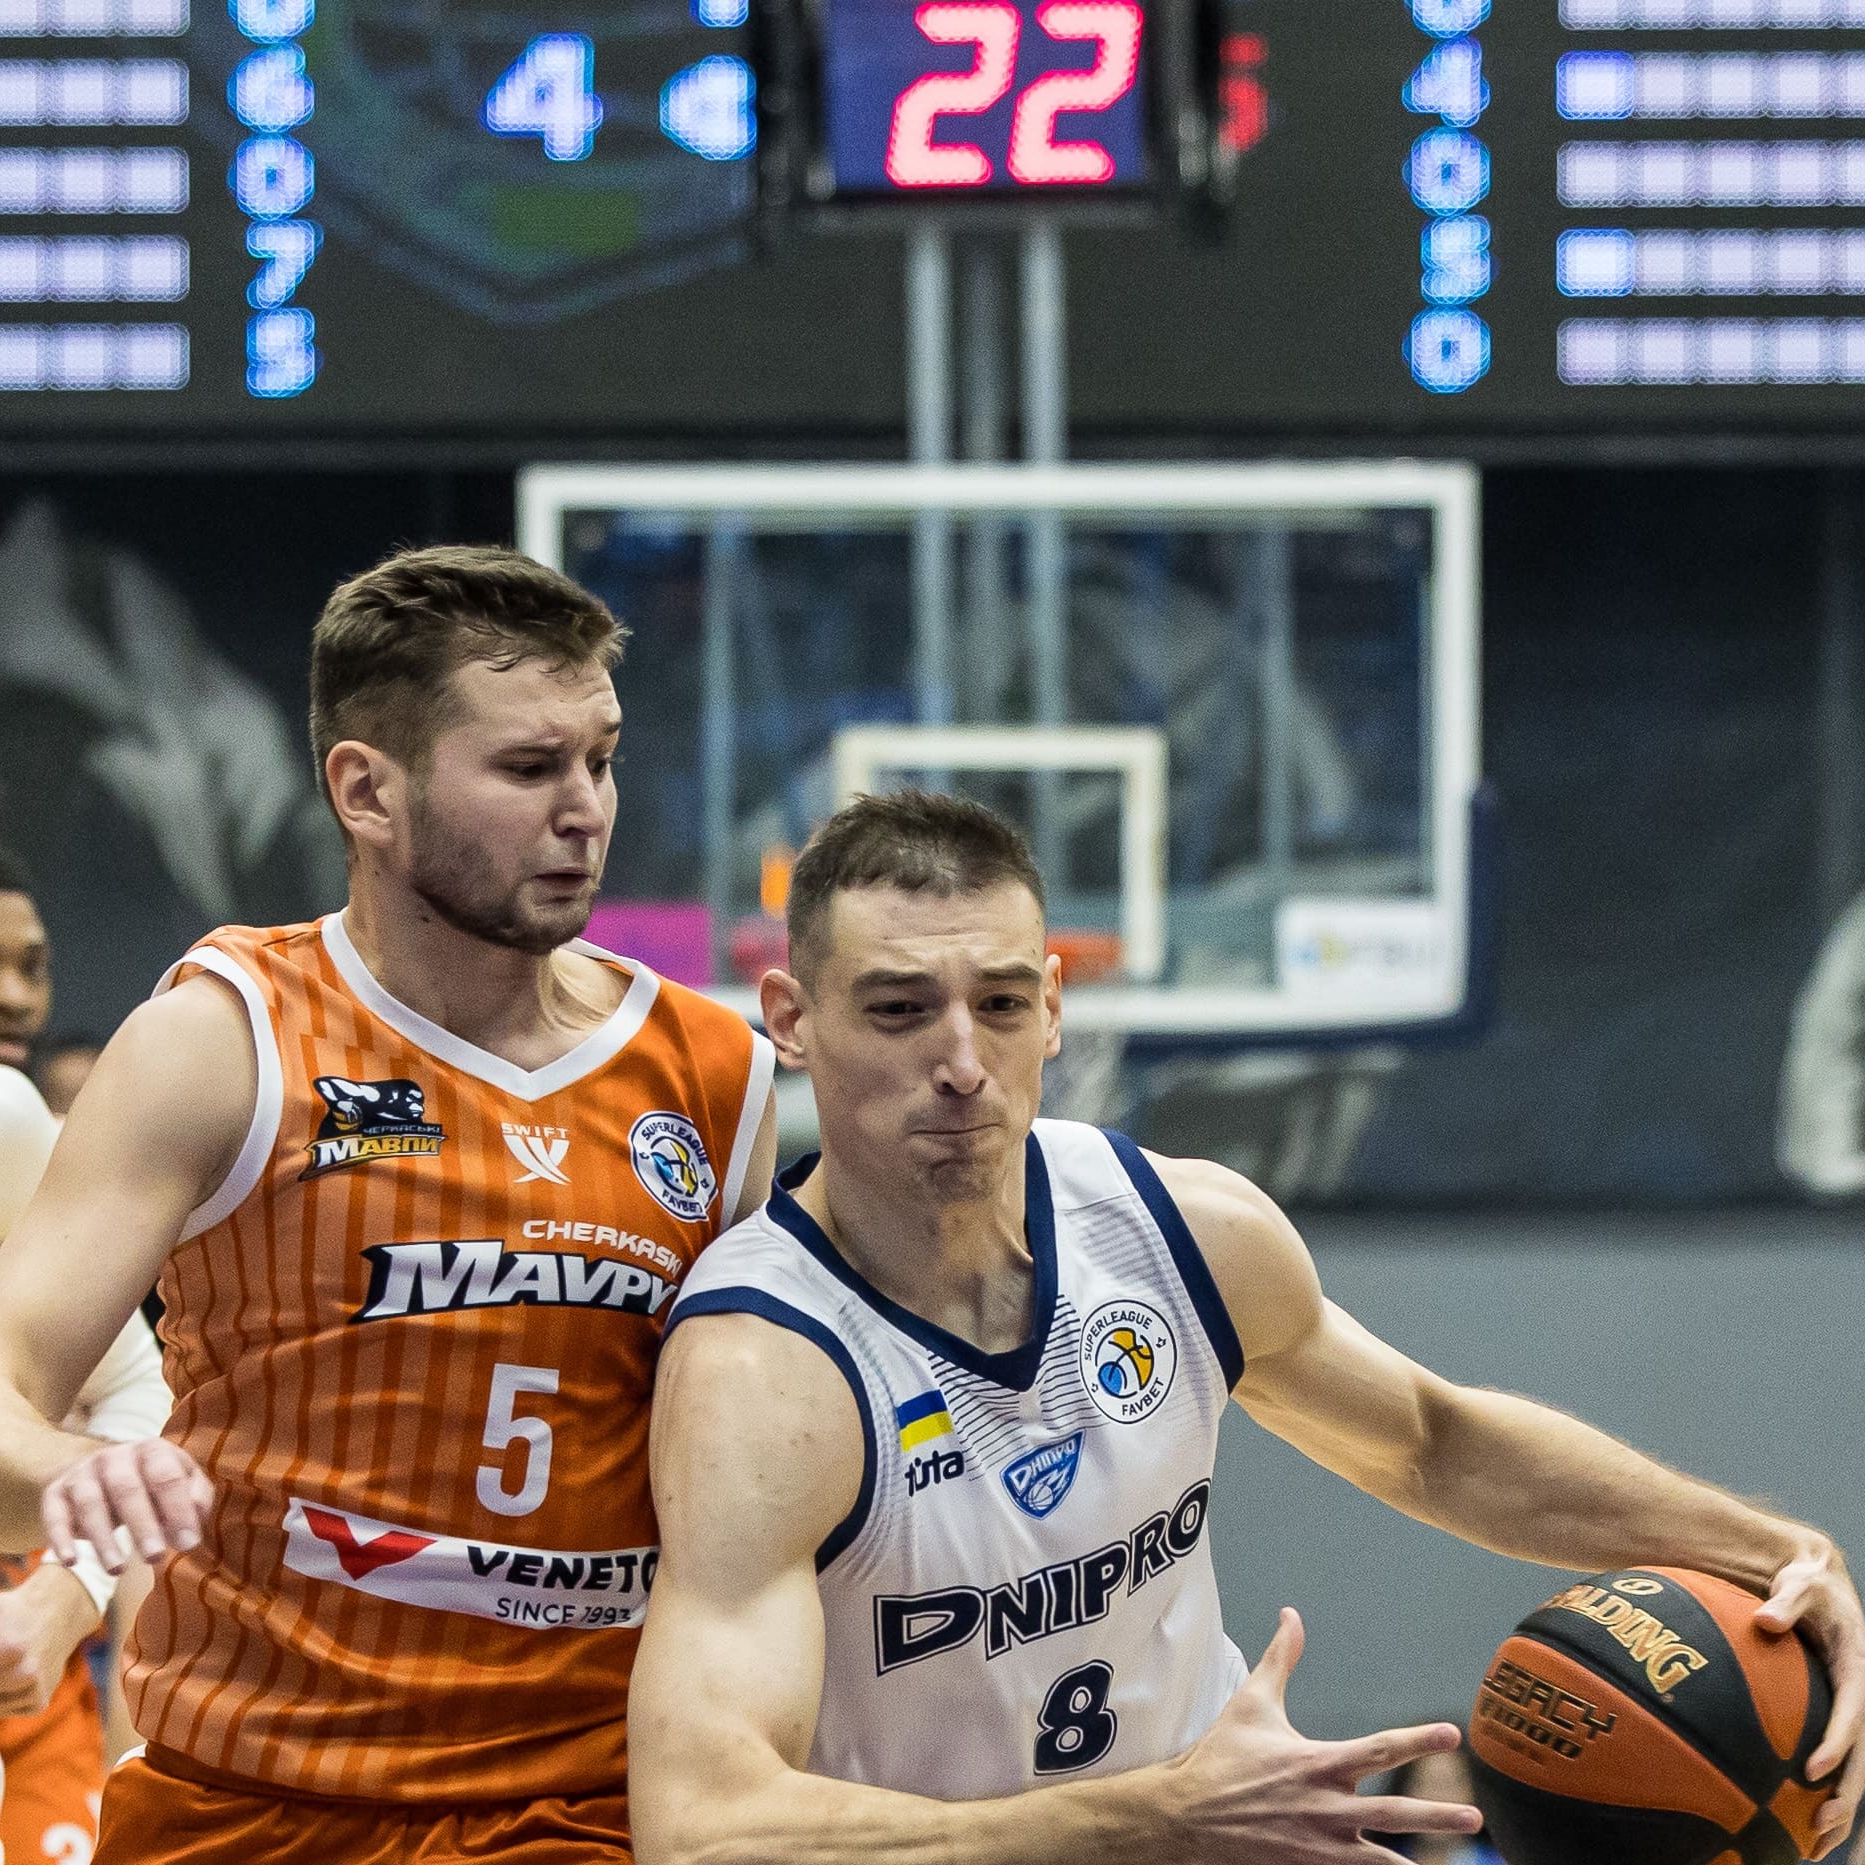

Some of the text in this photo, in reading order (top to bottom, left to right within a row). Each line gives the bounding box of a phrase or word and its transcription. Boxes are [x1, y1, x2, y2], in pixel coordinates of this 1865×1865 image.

[886, 0, 1139, 186] 22
[501, 1122, 569, 1139] SWIFT
[1085, 1310, 1153, 1361] SUPERLEAGUE
[1121, 1376, 1165, 1416] FAVBET
[476, 1363, 560, 1518] 5
[495, 1597, 635, 1626] SINCE 1993
[873, 1476, 1212, 1678] DNIPRO
[1033, 1659, 1119, 1776] 8
